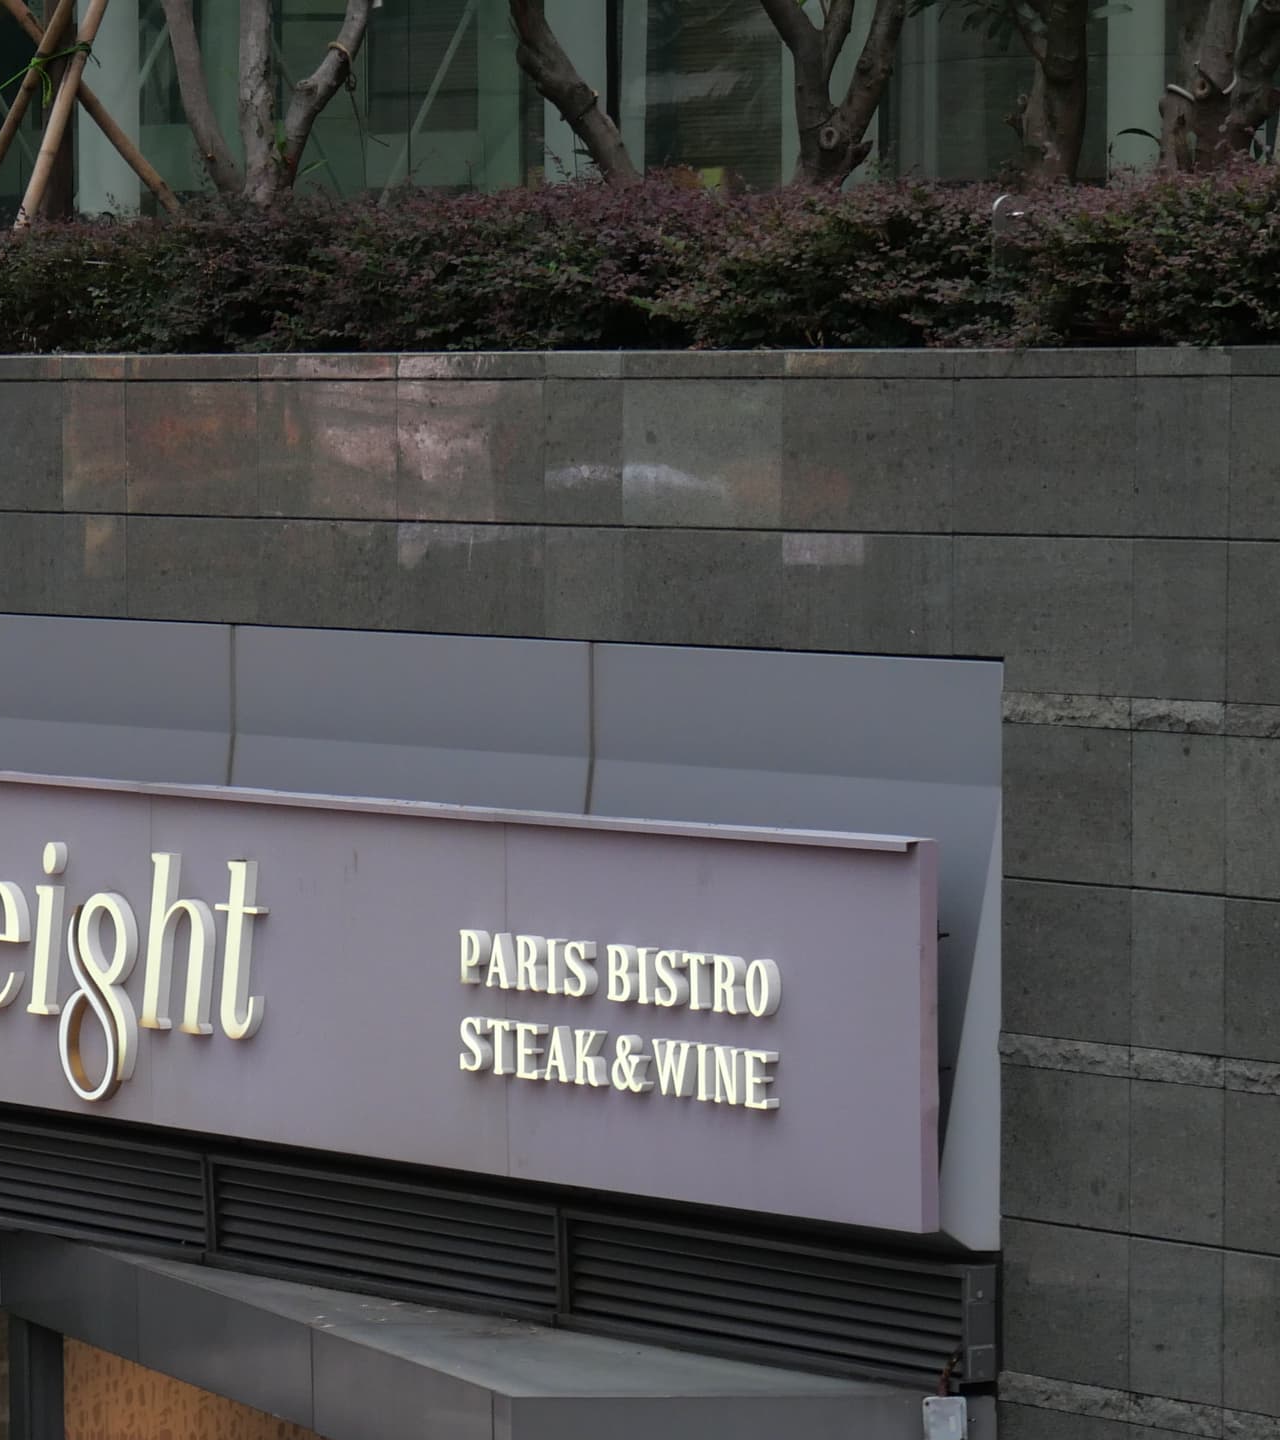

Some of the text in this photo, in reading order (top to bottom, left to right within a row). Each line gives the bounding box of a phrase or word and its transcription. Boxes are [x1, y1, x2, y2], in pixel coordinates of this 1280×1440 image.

[459, 928, 783, 1018] PARIS BISTRO
[459, 1016, 781, 1110] STEAK & WINE
